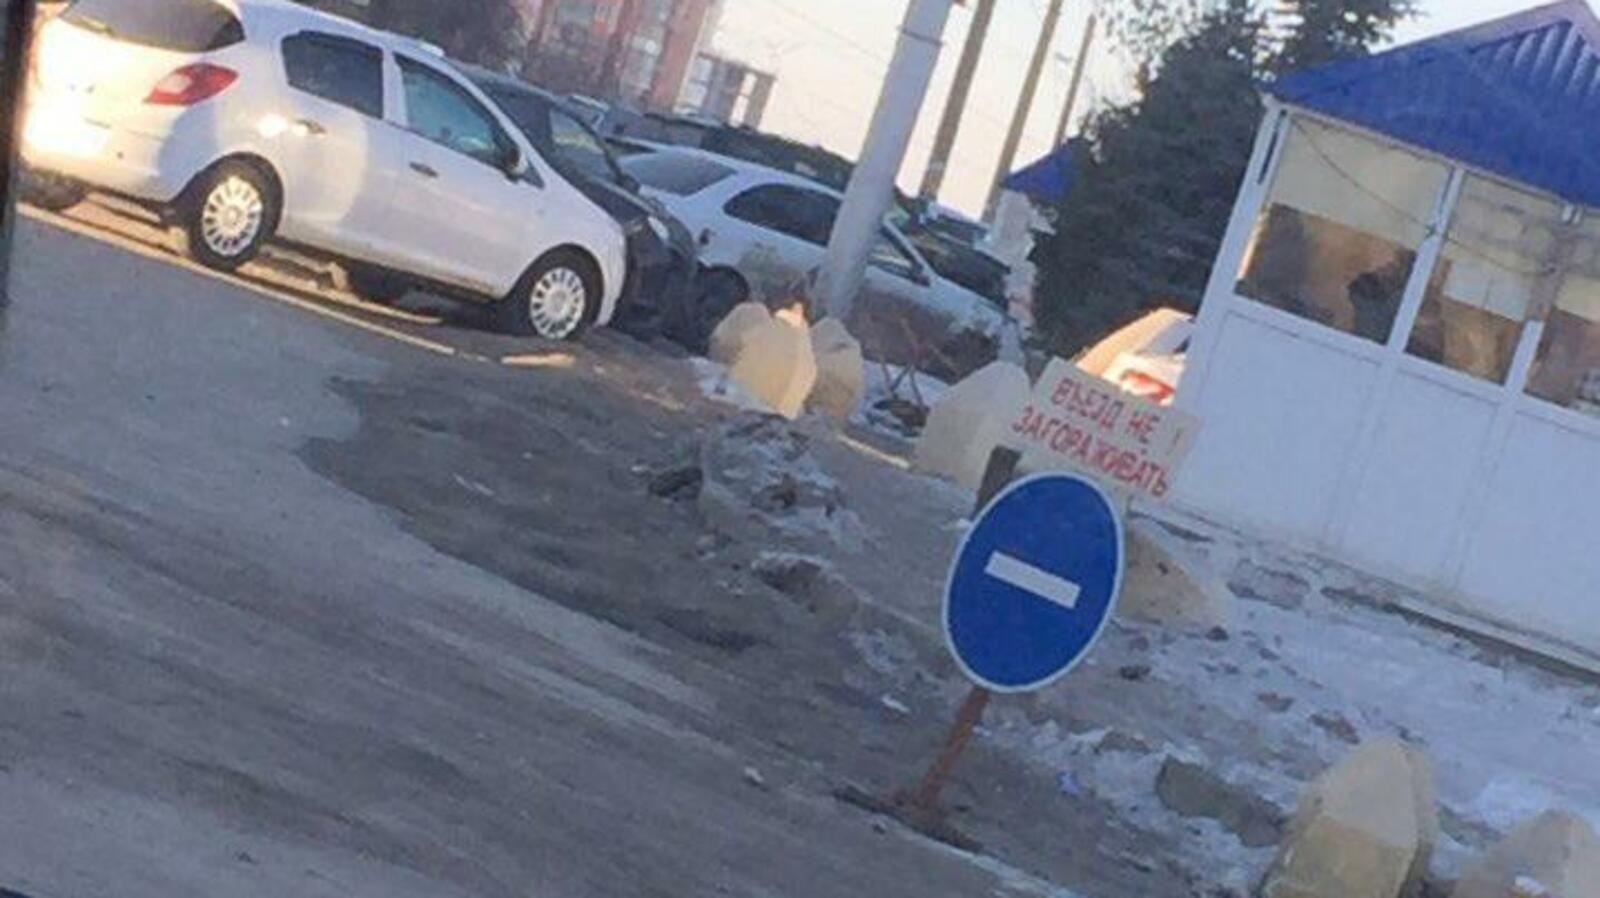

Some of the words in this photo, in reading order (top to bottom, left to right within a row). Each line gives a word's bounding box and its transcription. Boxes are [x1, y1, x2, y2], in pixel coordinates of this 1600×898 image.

[1051, 377, 1124, 429] ВЪЕЗД
[1127, 411, 1160, 444] НЕ
[1013, 405, 1168, 496] ЗАГОРАЖИВАТЬ
